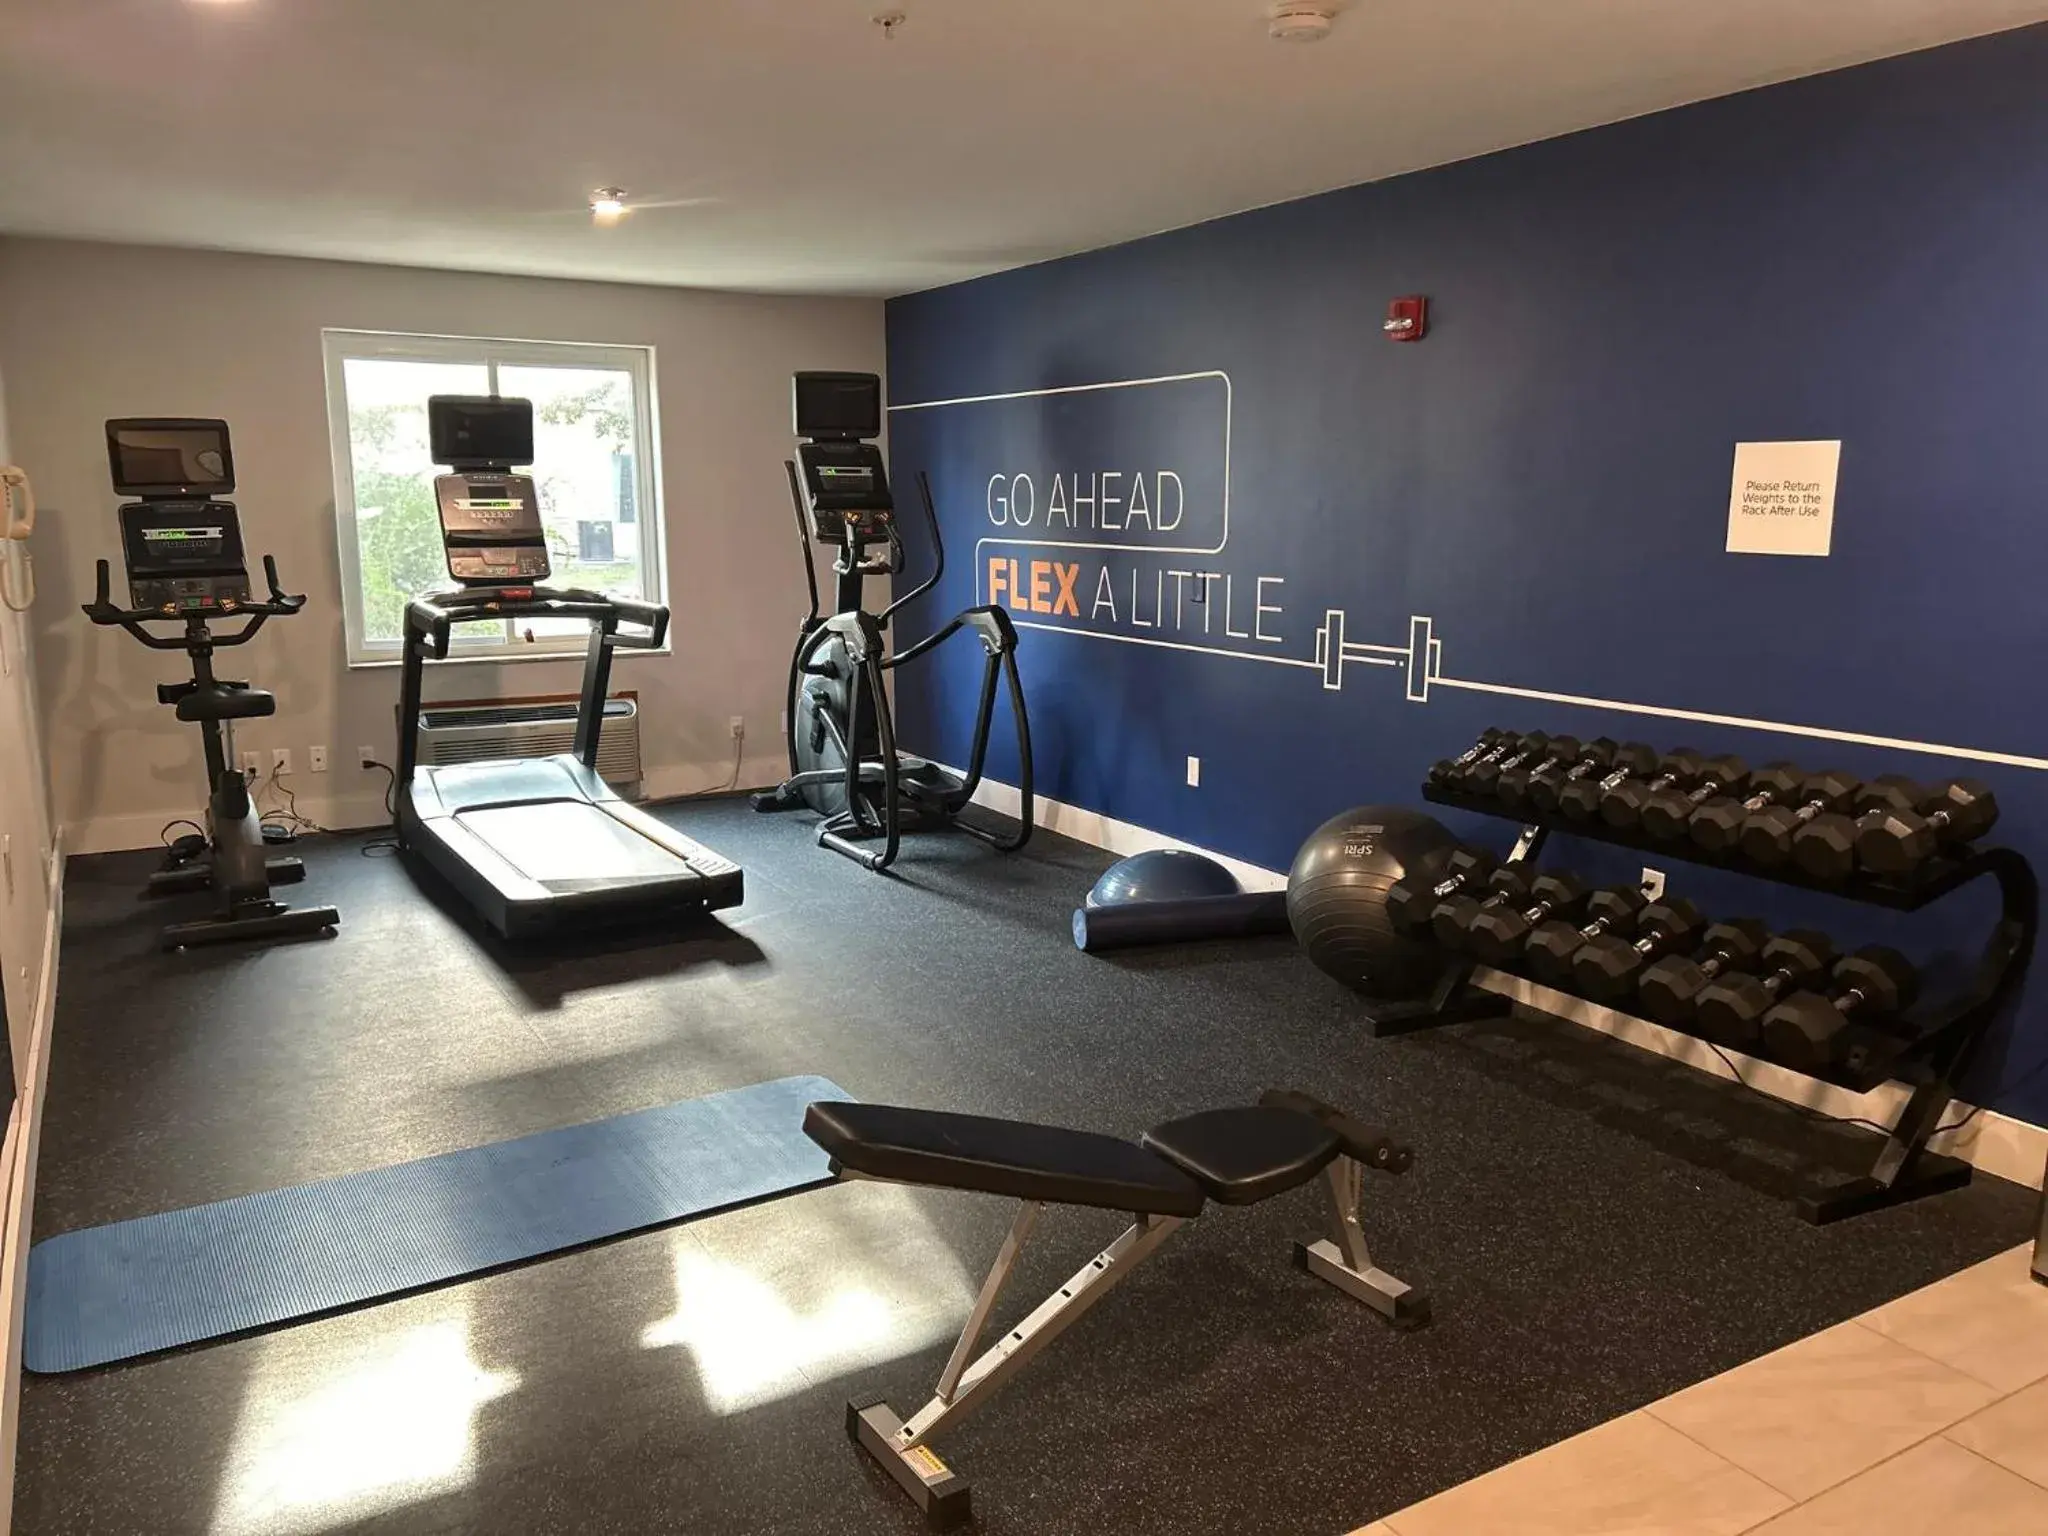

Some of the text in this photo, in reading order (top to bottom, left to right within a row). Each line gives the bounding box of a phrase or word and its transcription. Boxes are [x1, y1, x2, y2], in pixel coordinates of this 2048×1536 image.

[1745, 480, 1820, 492] Please Return
[987, 471, 1184, 531] GO AHEAD
[1742, 493, 1821, 505] Weights to the
[1741, 504, 1820, 517] Rack After Use
[989, 556, 1285, 643] FLEX A LITTLE
